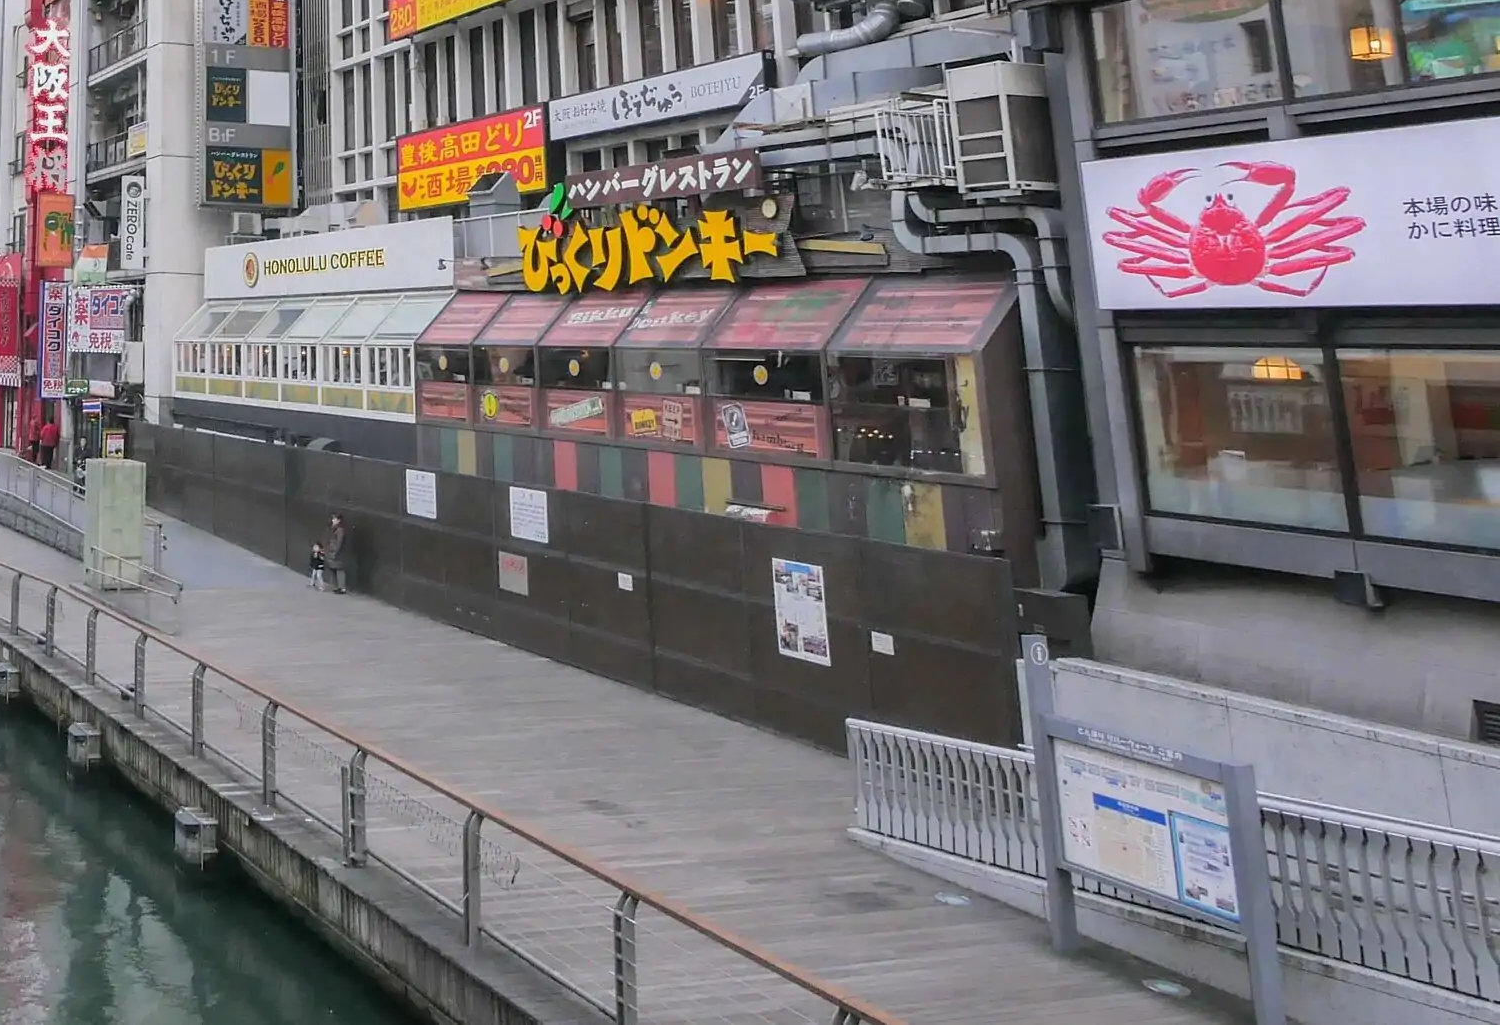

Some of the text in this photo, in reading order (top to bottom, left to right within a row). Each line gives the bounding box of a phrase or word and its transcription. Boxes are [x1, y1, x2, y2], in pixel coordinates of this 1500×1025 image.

[690, 76, 741, 98] BOTEJYU
[523, 108, 542, 130] 2F
[398, 119, 524, 170] 豊後高田どり
[213, 160, 256, 181] びっくり
[569, 157, 753, 203] ハンバーグレストラン
[211, 179, 259, 199] ドンキー
[1402, 192, 1500, 217] 本場の味
[126, 200, 138, 235] ZERO
[1407, 219, 1500, 240] かに料理
[518, 204, 778, 295] びっくりドンキー
[263, 247, 385, 276] HONOLULU COFFEE
[88, 330, 112, 349] 免税
